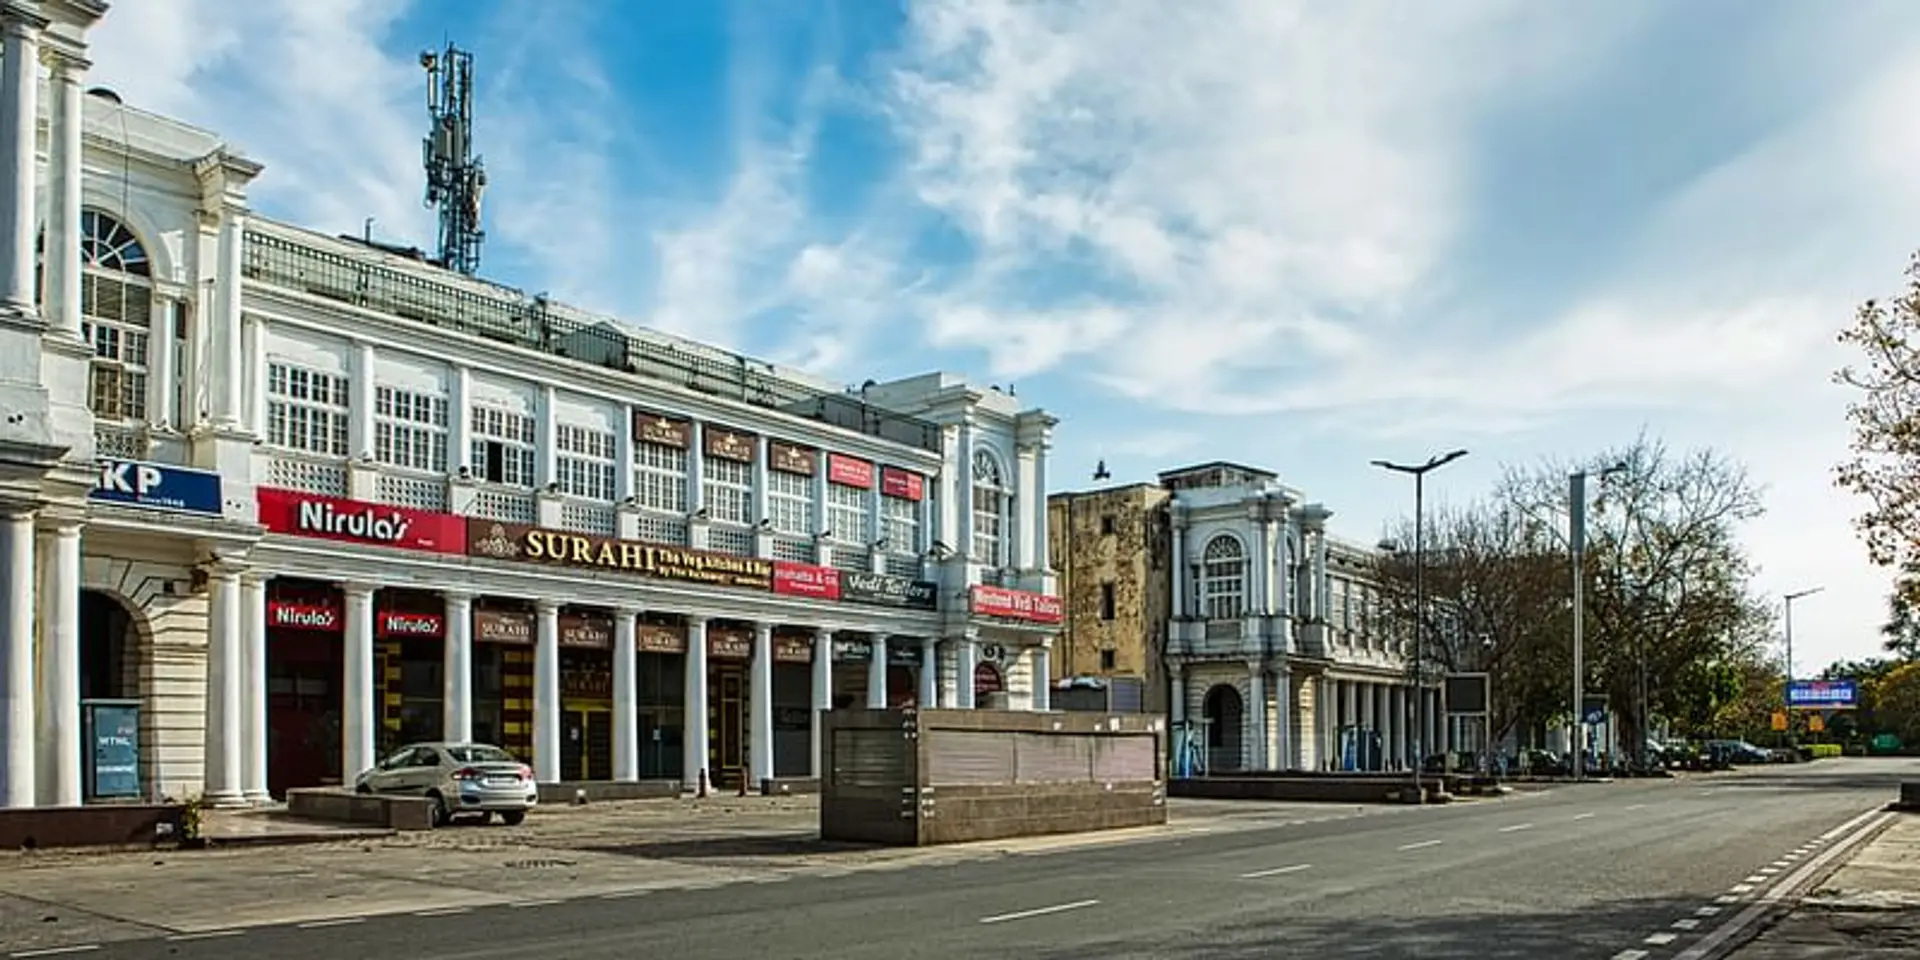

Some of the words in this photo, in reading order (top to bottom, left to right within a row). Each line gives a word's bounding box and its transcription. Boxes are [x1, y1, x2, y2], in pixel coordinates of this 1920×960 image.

[95, 461, 161, 493] KP
[301, 500, 408, 540] Nirula's
[526, 529, 656, 571] SURAHI
[849, 575, 882, 593] Vedi
[276, 607, 335, 627] Nirula's
[387, 616, 438, 634] Nirula's
[481, 622, 530, 636] SURAHI
